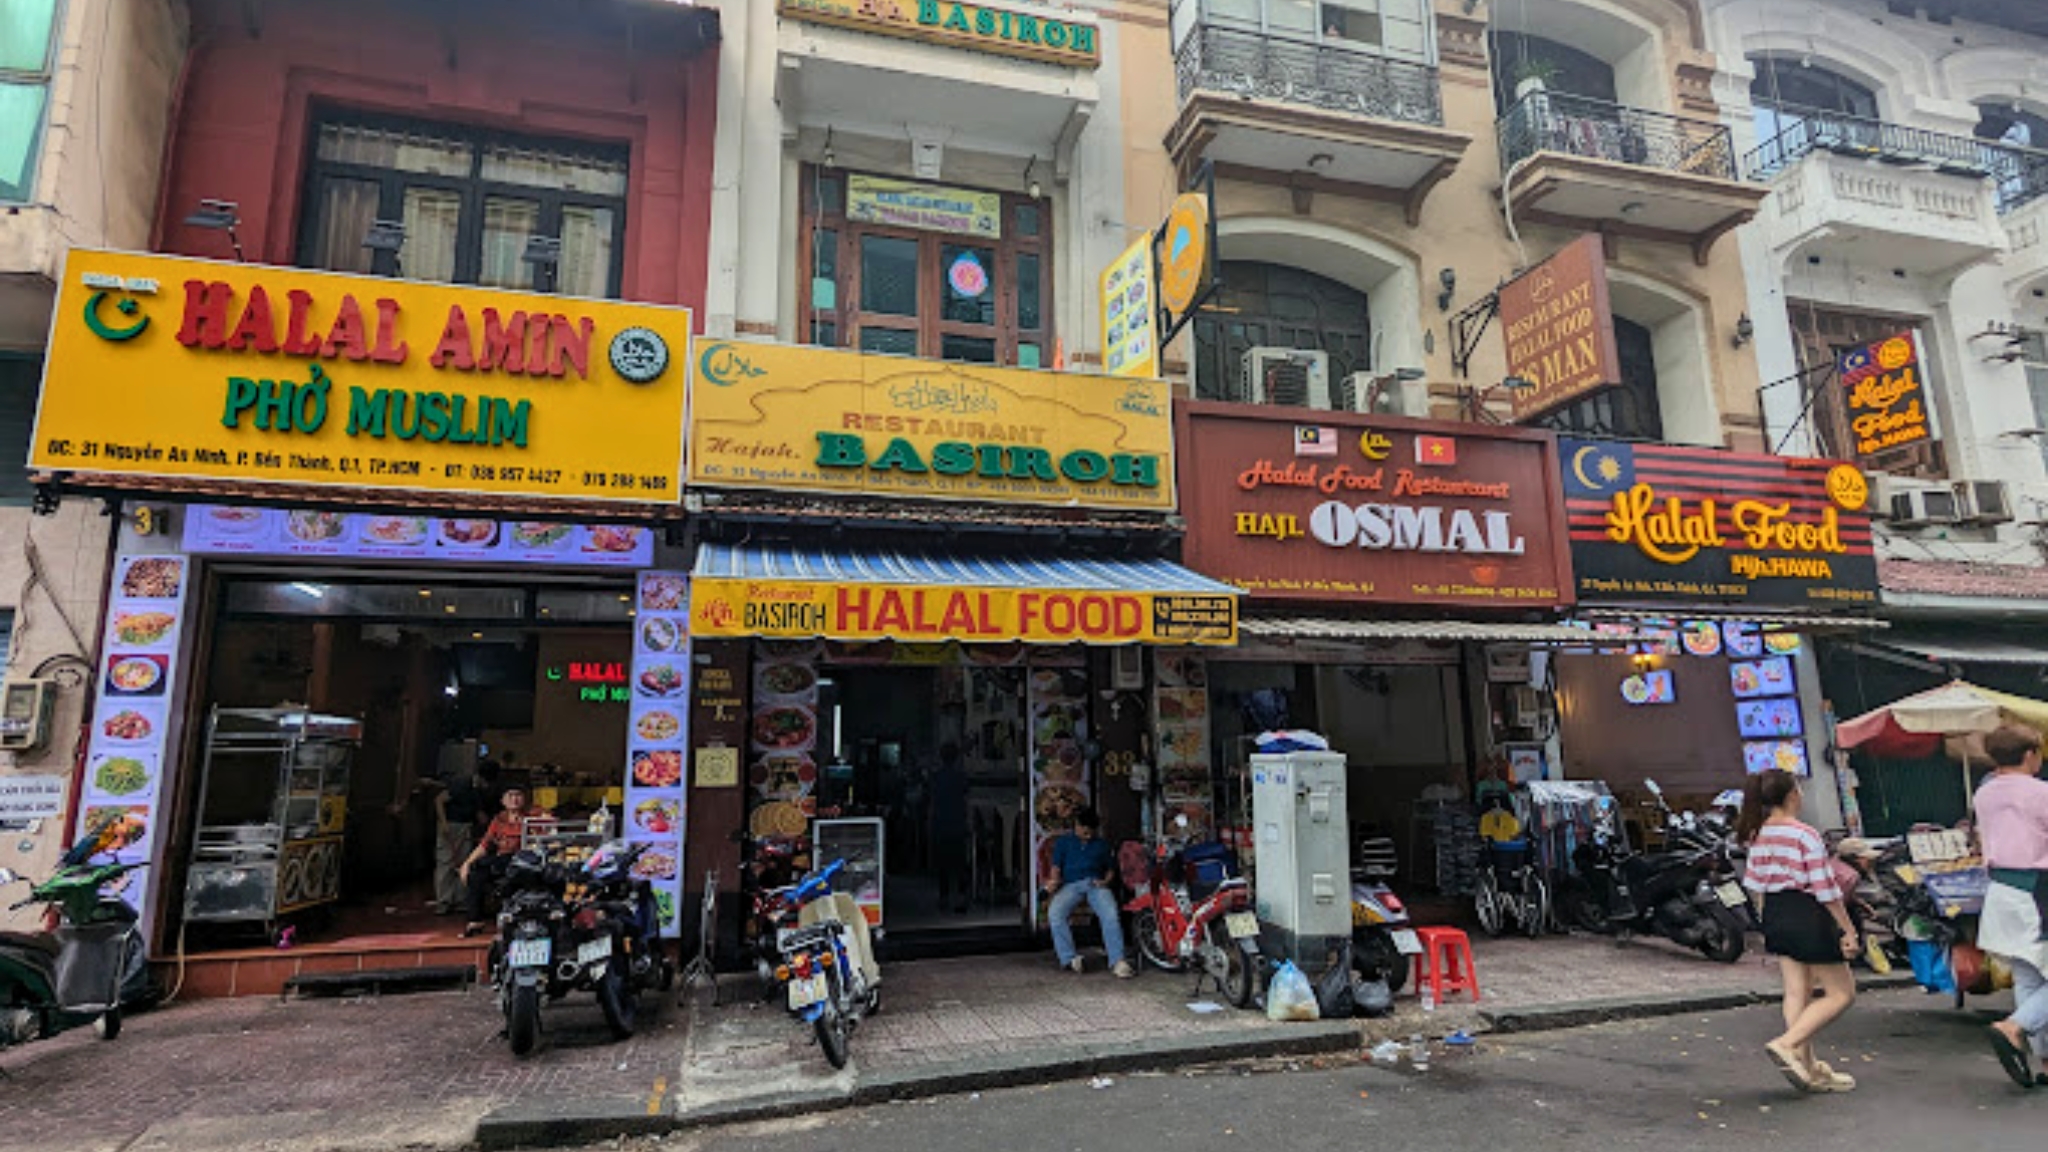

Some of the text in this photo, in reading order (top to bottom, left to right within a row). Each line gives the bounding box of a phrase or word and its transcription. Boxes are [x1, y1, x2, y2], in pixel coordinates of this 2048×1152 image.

[916, 0, 1095, 53] BASIROH
[175, 279, 409, 364] HALAL
[429, 304, 594, 380] AMIN
[221, 363, 532, 448] PHỞ MUSLIM
[1848, 367, 1919, 409] Halal
[842, 412, 1048, 444] RESTAURANT
[1852, 398, 1925, 438] Food
[81, 440, 98, 457] 31
[815, 431, 1160, 487] BASIROH
[1237, 459, 1510, 499] Halal Food Restaurant
[1309, 500, 1525, 554] OSMAL
[1605, 482, 1848, 565] Halal Food
[745, 602, 826, 630] BASIROH
[836, 587, 1003, 634] HALAL
[1018, 593, 1143, 637] FOOD
